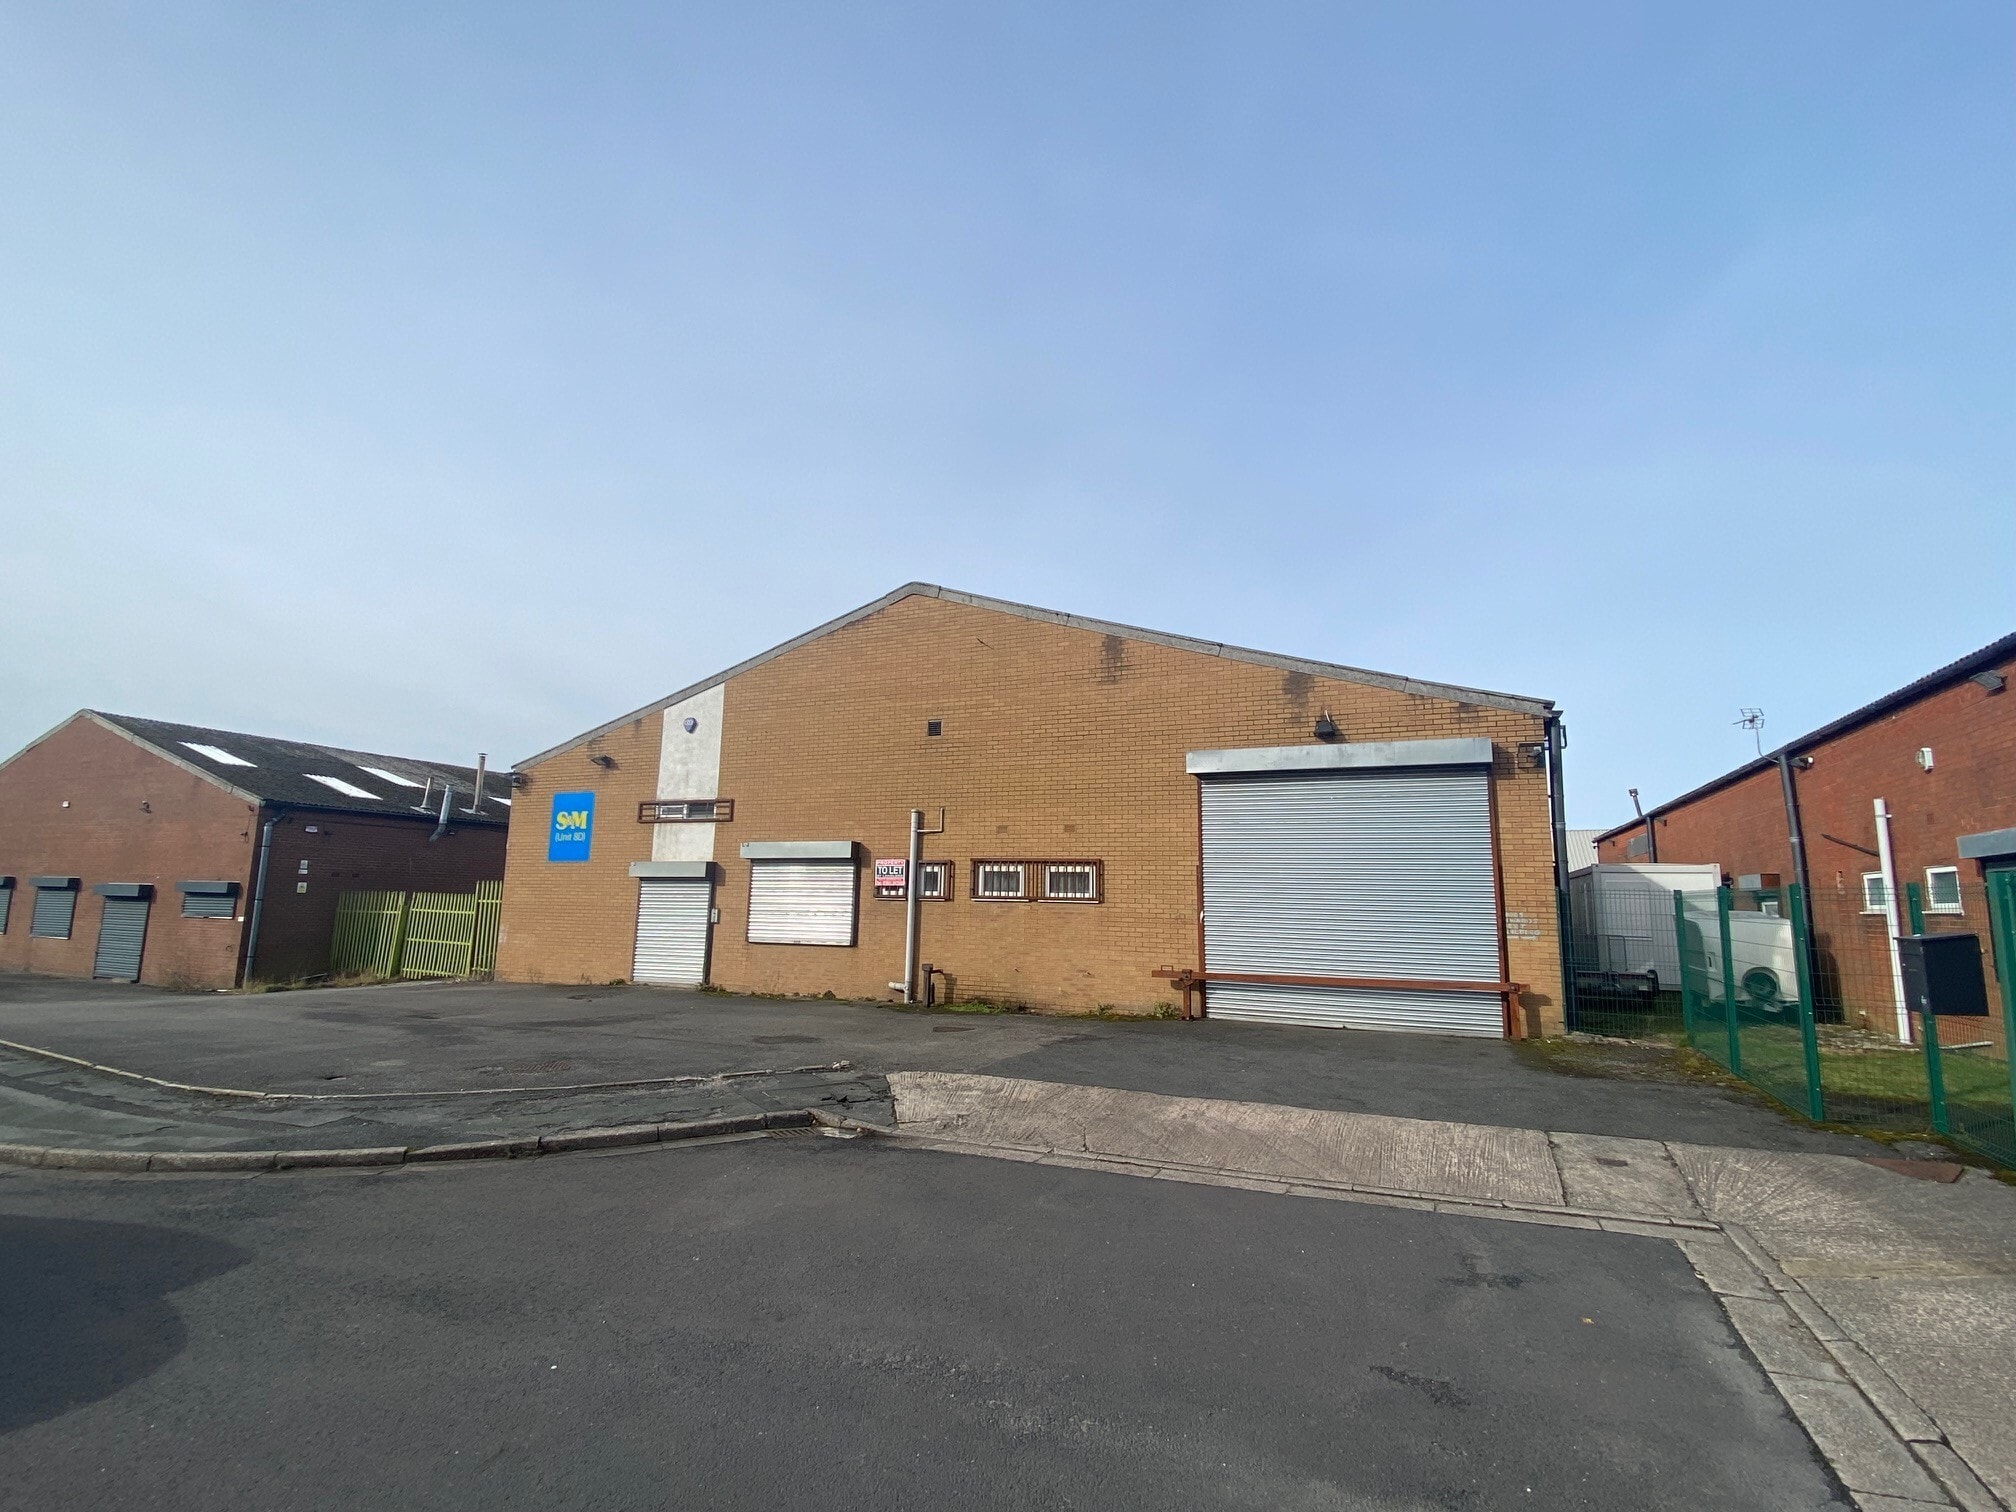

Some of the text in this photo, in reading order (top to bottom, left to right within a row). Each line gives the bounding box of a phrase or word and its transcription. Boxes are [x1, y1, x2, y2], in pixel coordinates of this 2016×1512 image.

[555, 811, 588, 830] S&M
[878, 866, 902, 874] TO LET
